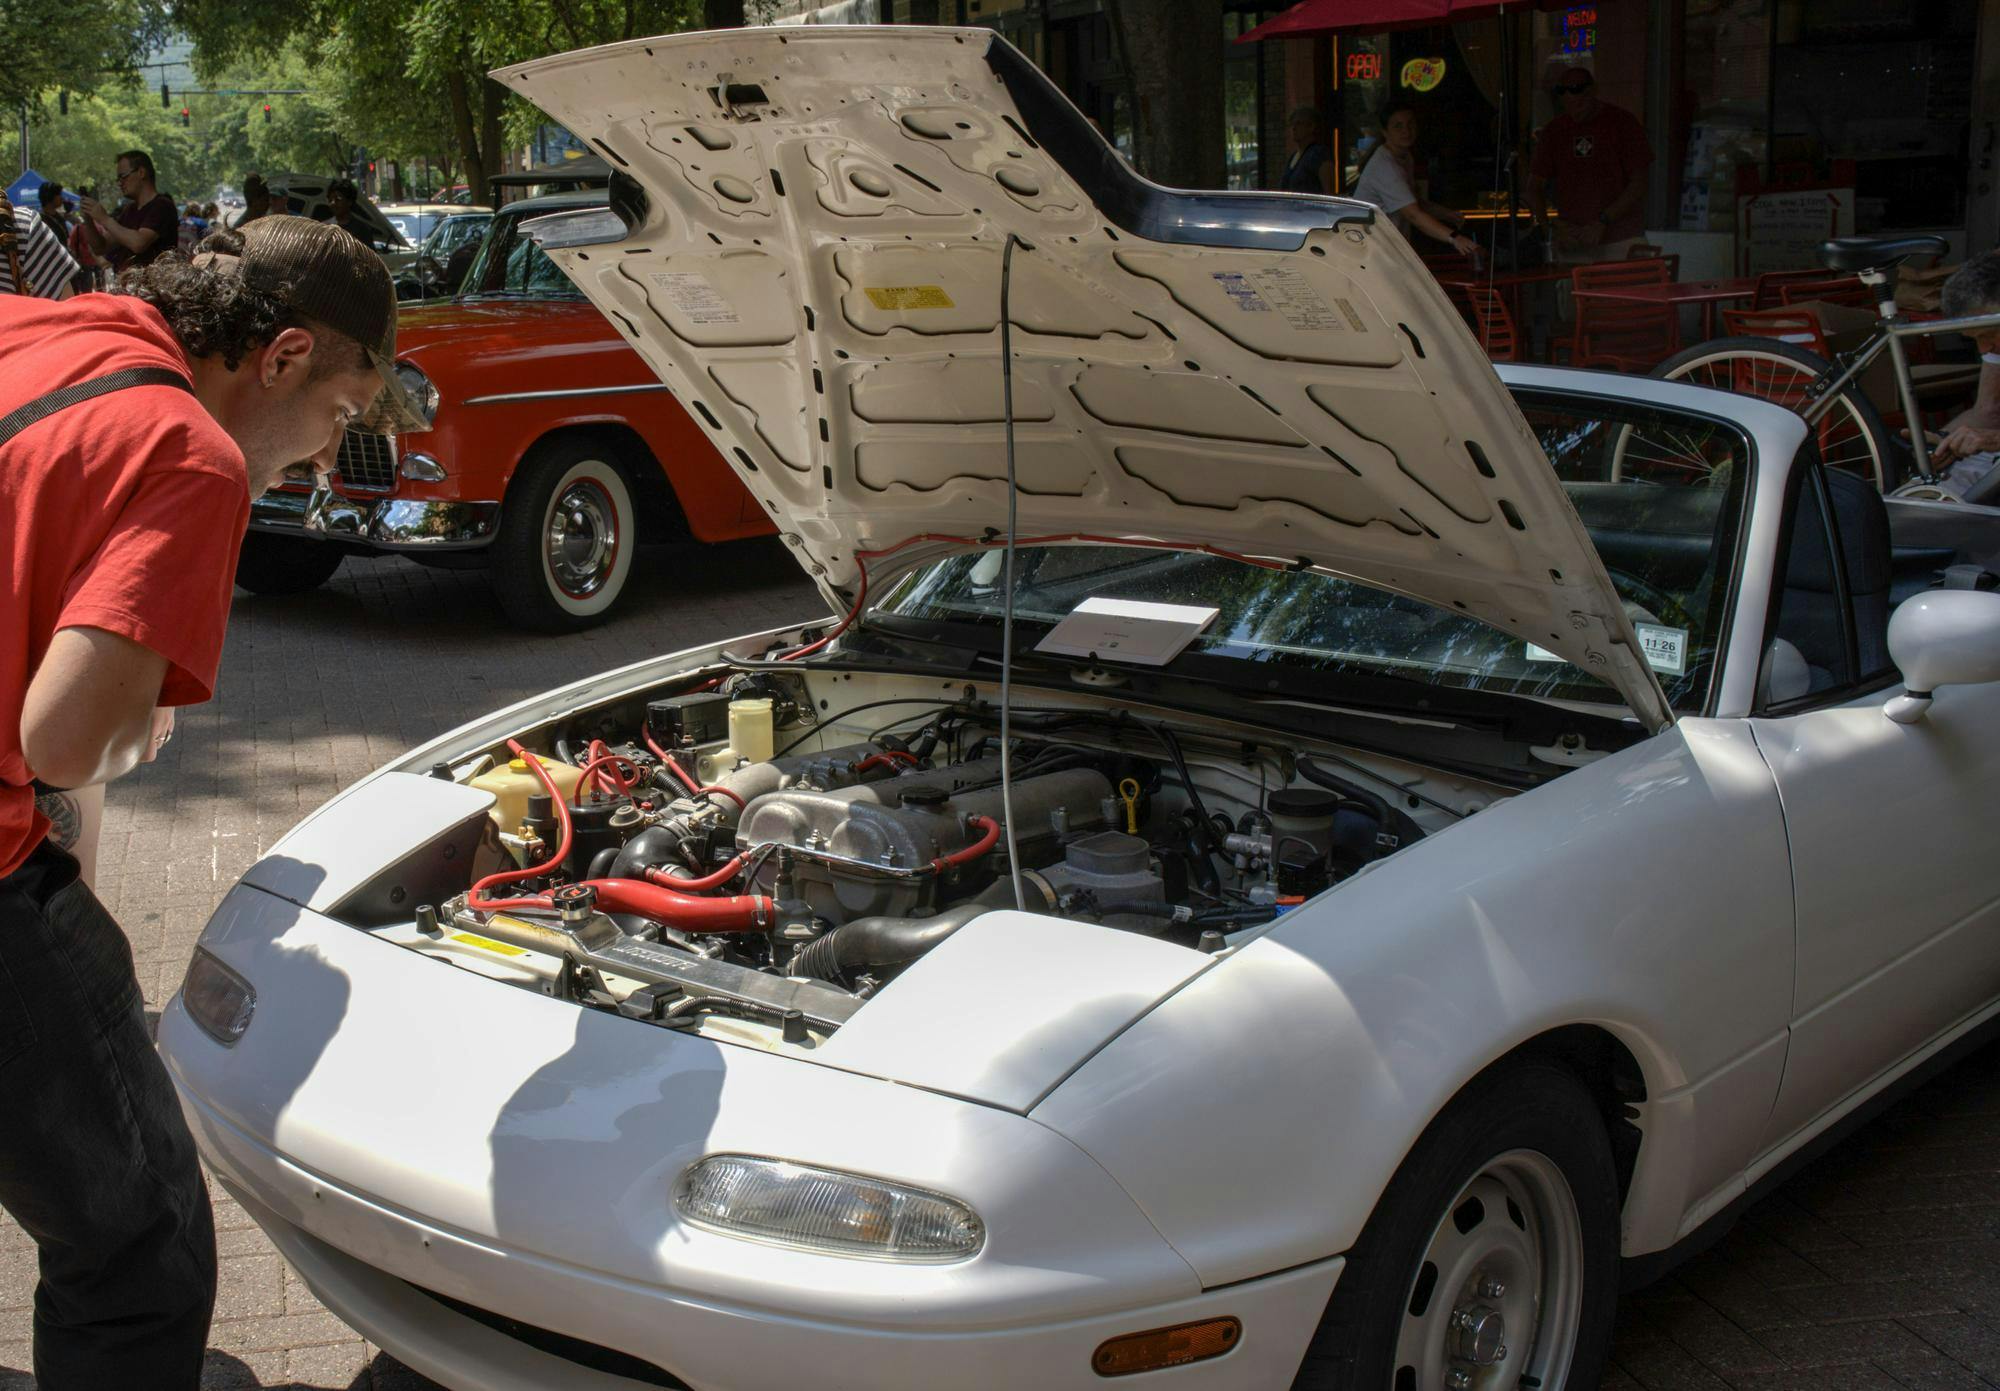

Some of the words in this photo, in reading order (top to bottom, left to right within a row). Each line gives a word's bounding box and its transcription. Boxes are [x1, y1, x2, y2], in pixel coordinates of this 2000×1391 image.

[1347, 53, 1382, 79] OPEN
[1645, 638, 1657, 648] 11
[1661, 640, 1676, 651] 26
